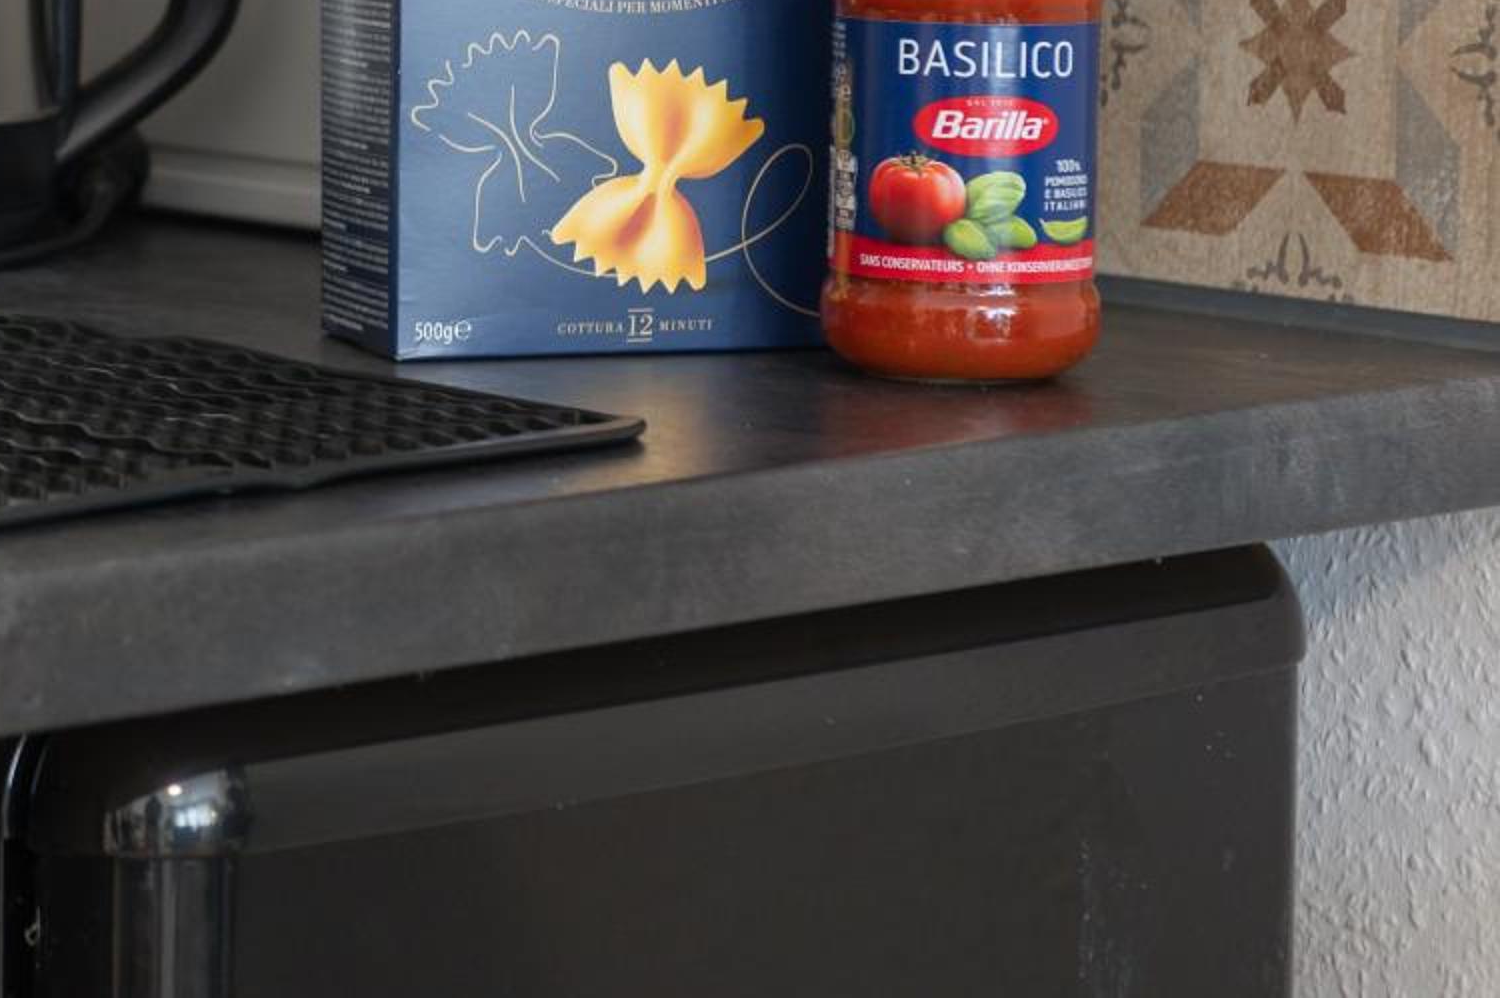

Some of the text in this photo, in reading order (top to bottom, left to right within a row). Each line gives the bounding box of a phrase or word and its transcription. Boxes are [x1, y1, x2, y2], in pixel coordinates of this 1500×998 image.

[616, 0, 646, 14] PER
[898, 38, 1073, 79] BASILICO
[931, 110, 1044, 140] Barilla
[860, 254, 880, 266] SANS
[881, 257, 964, 272] CONSERVATEURS
[557, 313, 712, 337] COTTURA 12 MINUTI
